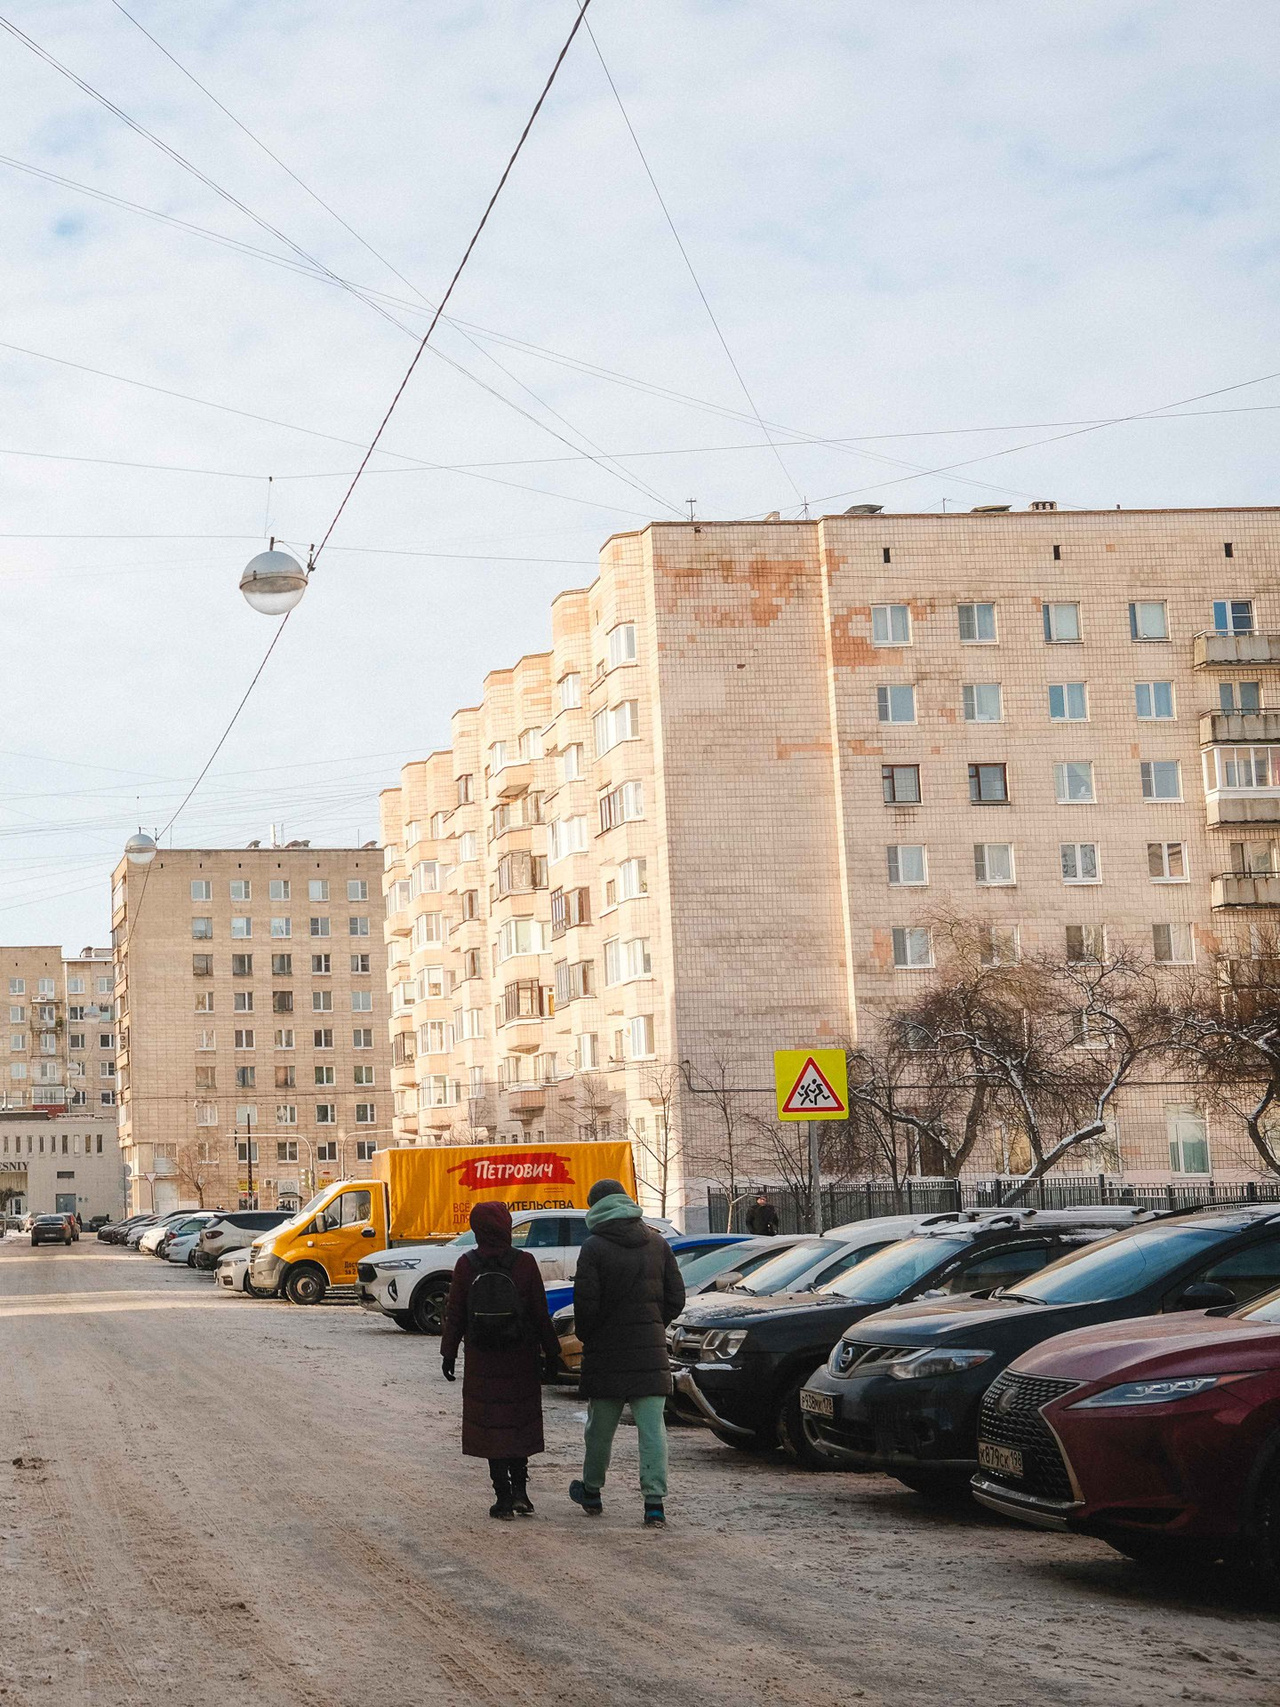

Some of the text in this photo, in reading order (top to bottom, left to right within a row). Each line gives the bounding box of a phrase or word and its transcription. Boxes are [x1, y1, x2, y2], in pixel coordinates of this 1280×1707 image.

[453, 1200, 470, 1213] ВСЁ
[501, 1200, 574, 1211] ИТЕЛЬСТВА
[453, 1214, 470, 1225] ДЛЯ
